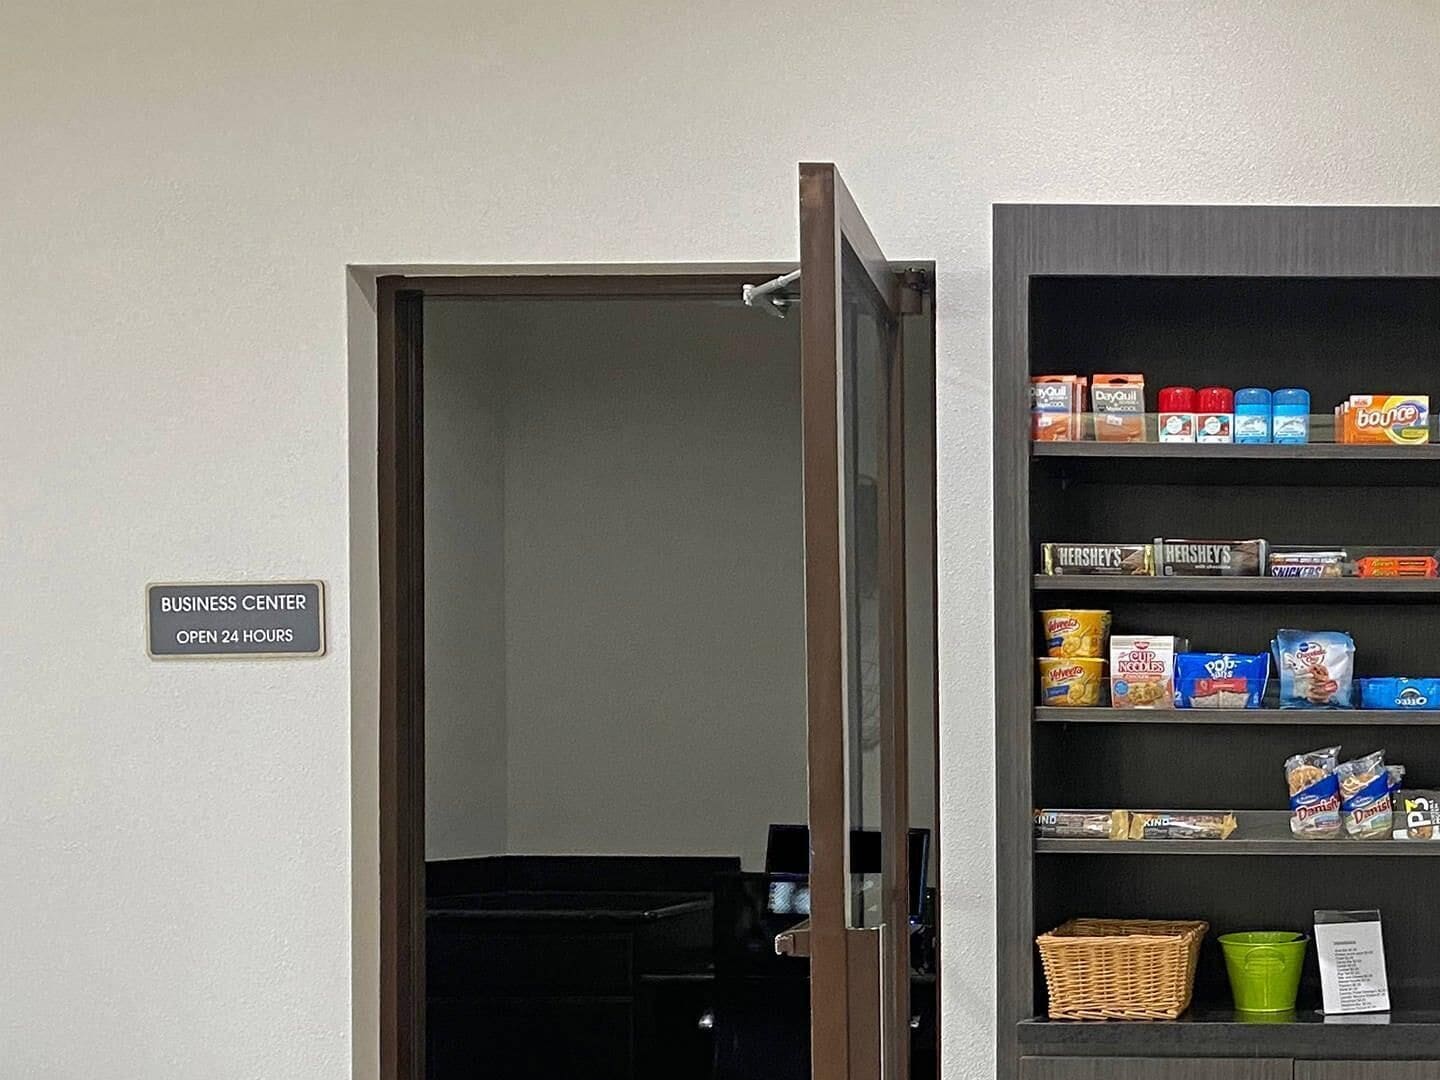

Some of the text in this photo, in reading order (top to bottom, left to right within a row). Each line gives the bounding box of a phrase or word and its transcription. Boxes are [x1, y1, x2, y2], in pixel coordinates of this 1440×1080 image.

[1095, 391, 1137, 403] DayQuil
[1356, 406, 1417, 428] bounce
[1059, 547, 1122, 567] HERSHEY'S
[1165, 544, 1232, 564] HERSHEY'S
[161, 594, 306, 612] BUSINESS CENTER
[176, 629, 293, 643] OPEN 24 HOURS
[1129, 651, 1156, 662] CUP
[1118, 661, 1165, 673] NOODLES
[1296, 796, 1339, 821] Danish
[1143, 818, 1170, 827] KIND
